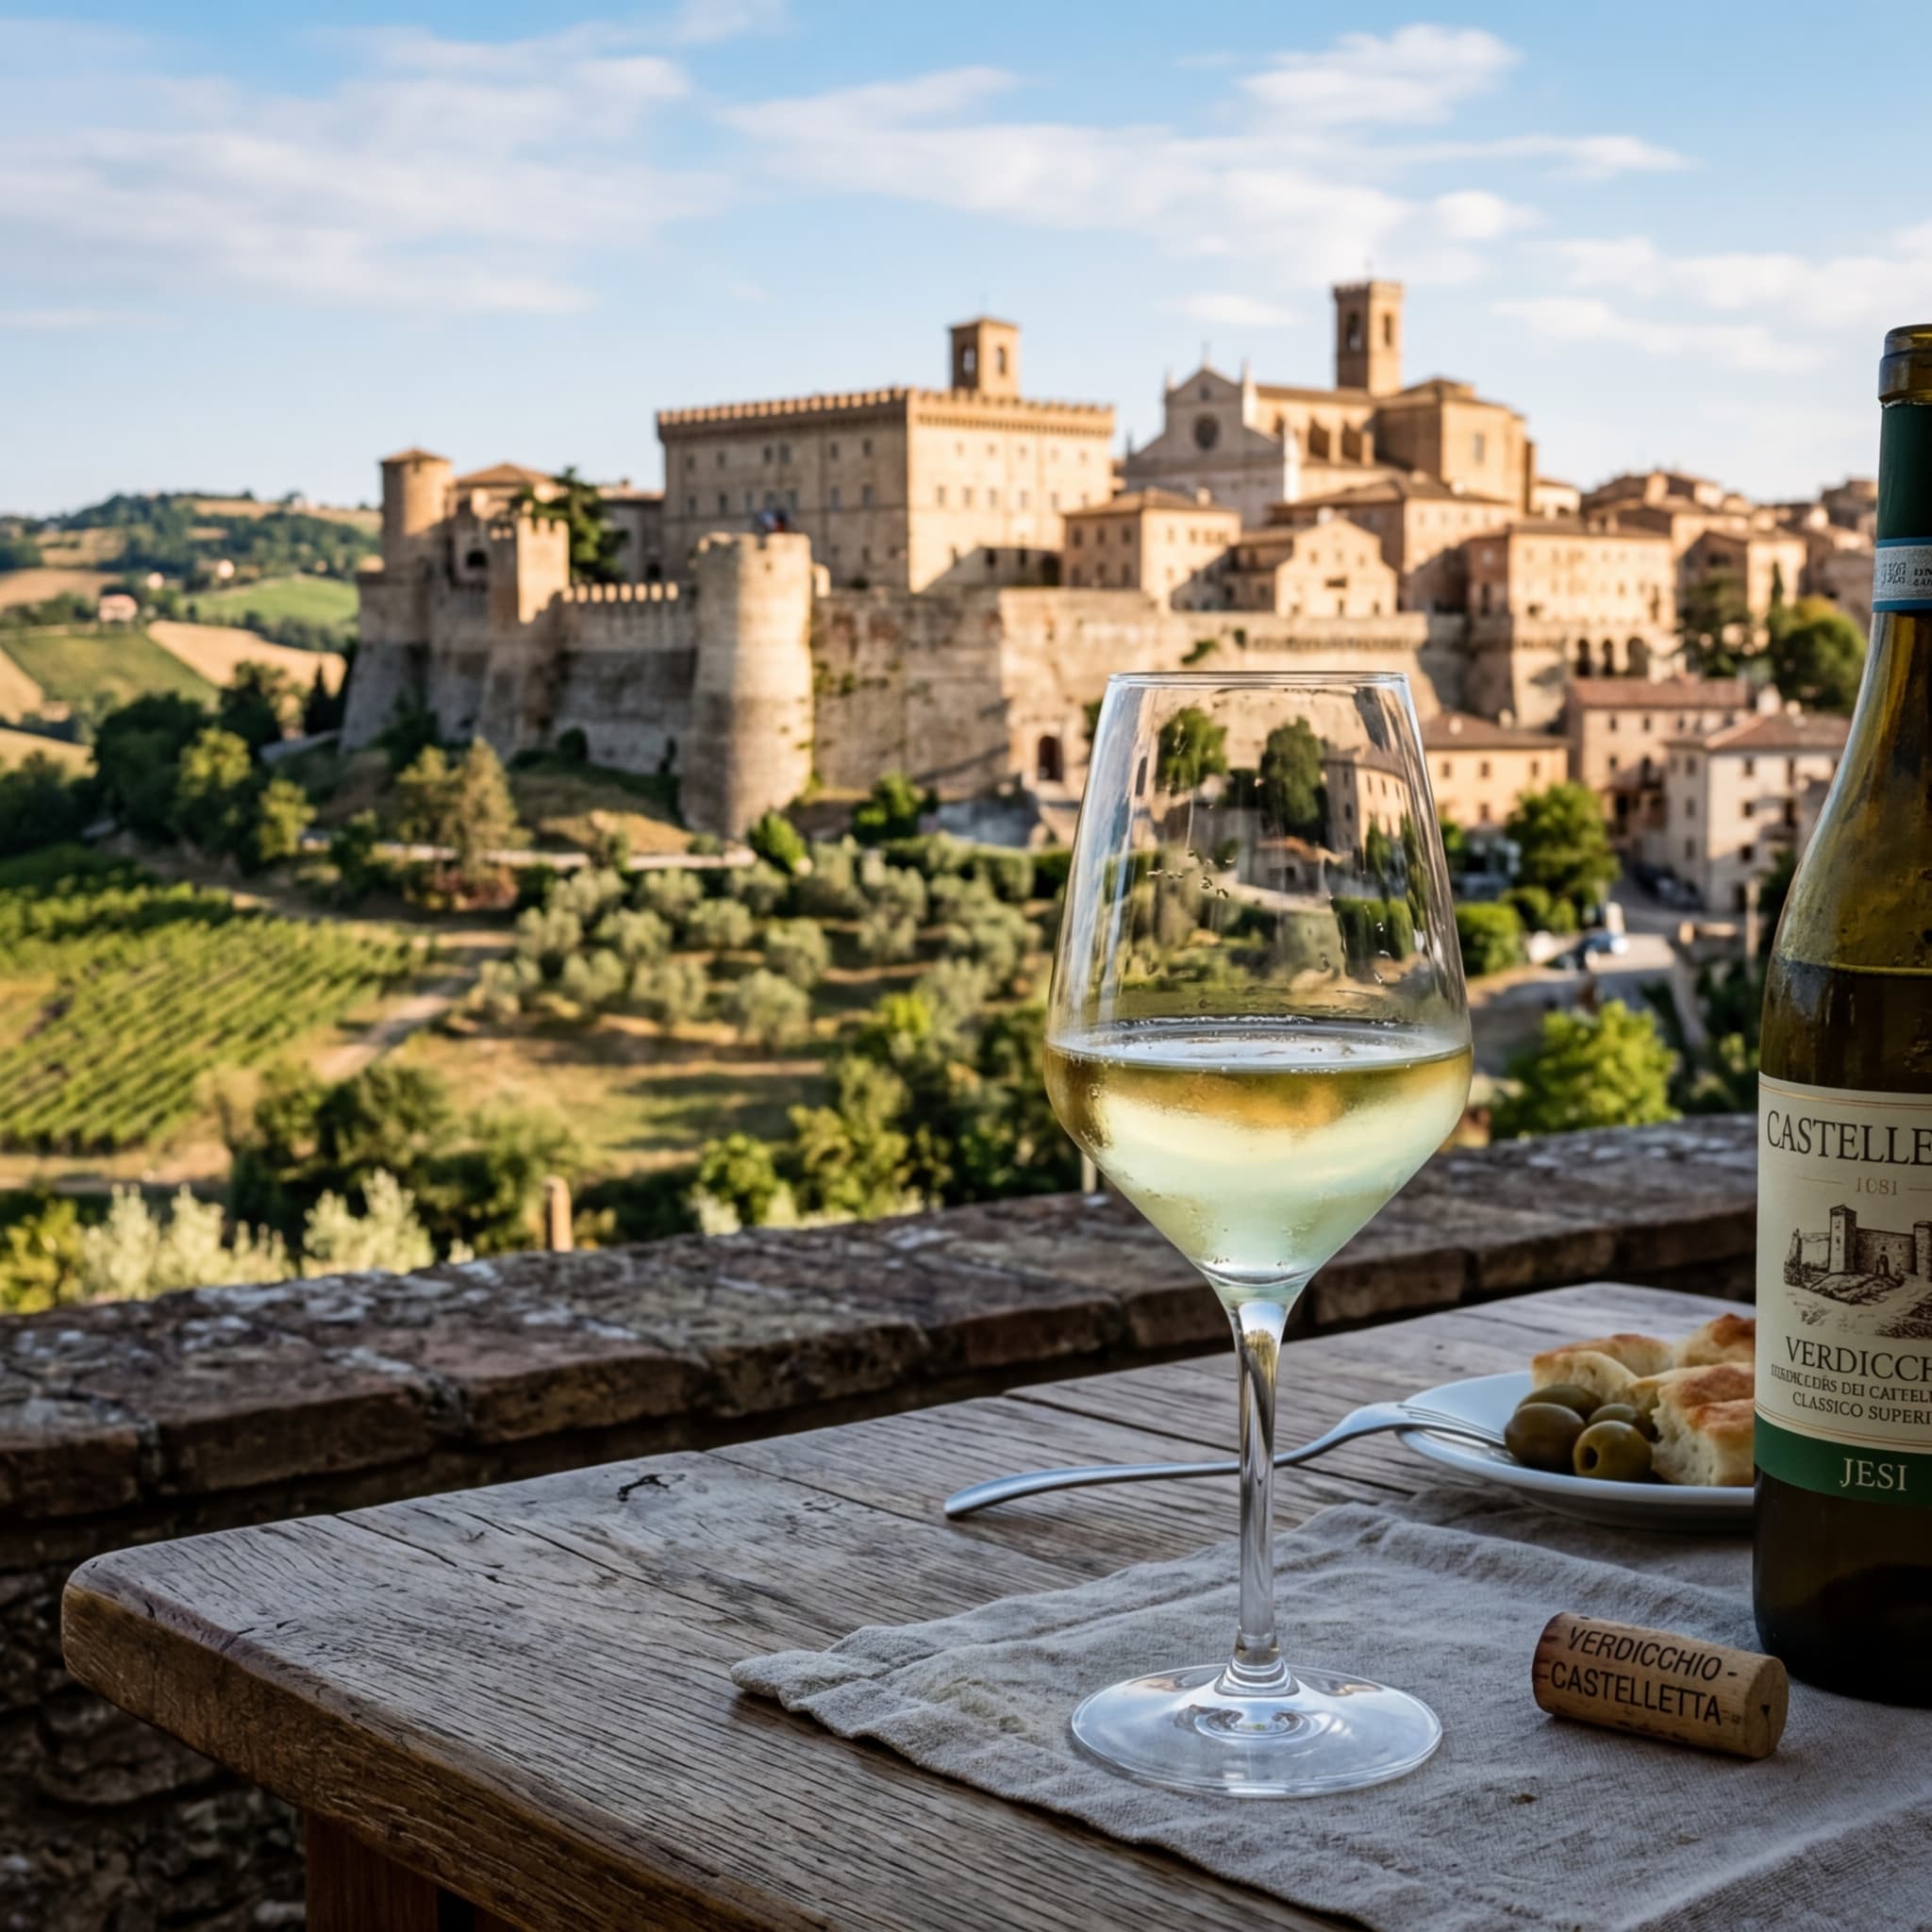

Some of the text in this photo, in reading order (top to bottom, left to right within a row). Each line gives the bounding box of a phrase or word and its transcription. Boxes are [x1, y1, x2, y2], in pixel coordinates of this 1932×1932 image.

[1767, 1109, 1932, 1166] CASTELLE
[1792, 1391, 1863, 1418] CLASSICO
[1841, 1381, 1865, 1397] DEI
[1840, 1457, 1907, 1491] JESI
[1568, 1626, 1723, 1681] VERDICCHIO
